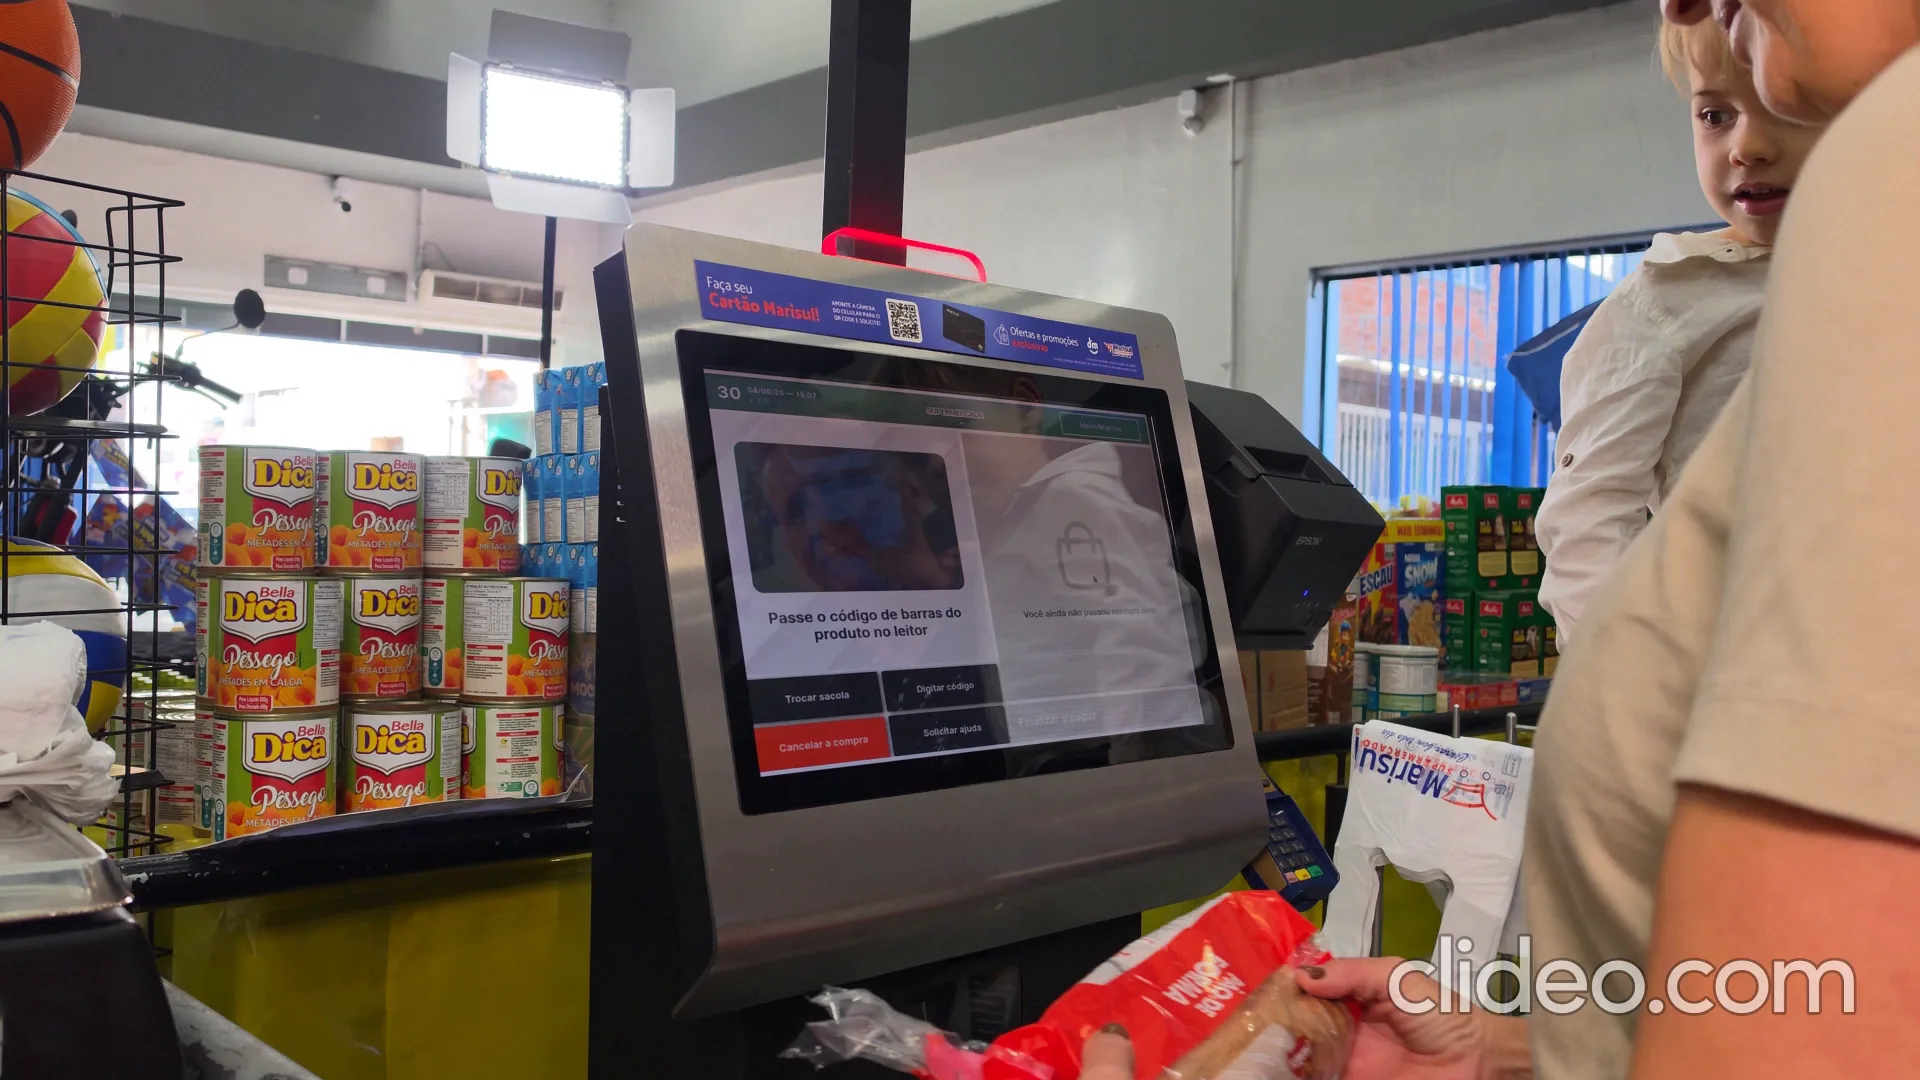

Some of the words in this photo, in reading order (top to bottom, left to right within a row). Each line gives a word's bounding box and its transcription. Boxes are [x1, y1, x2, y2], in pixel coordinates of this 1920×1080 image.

[706, 276, 732, 294] Faça
[734, 284, 752, 294] seu
[708, 291, 760, 313] Cartão
[764, 301, 820, 322] Marisul!
[831, 301, 851, 309] APONTE
[856, 303, 876, 312] CÂMERA
[841, 308, 862, 317] CELULAR
[1010, 326, 1036, 340] Ofertas
[1036, 332, 1042, 340] e
[1042, 334, 1078, 347] promoções
[1011, 339, 1048, 353] exclusivas
[717, 385, 741, 400] 30
[253, 458, 314, 488] Dica
[394, 459, 416, 470] Bella
[353, 462, 418, 491] Dica
[484, 468, 522, 495] Dic
[352, 510, 416, 542] Pêssego
[247, 539, 287, 548] METADES
[348, 540, 388, 549] METADES
[1296, 536, 1323, 546] EPSON
[1360, 564, 1394, 596] ESCAU
[1405, 556, 1438, 588] SNOW
[259, 586, 295, 598] Bella
[399, 585, 418, 595] Bella
[224, 591, 298, 622] Dica
[360, 589, 419, 617] Dica
[529, 591, 569, 619] Dic
[769, 611, 813, 624] Passe
[817, 614, 826, 622] o
[830, 609, 877, 624] código
[881, 608, 898, 620] de
[901, 608, 942, 619] barras
[946, 607, 962, 618] do
[1023, 610, 1043, 618] Você
[1045, 609, 1066, 618] ainda
[1068, 608, 1082, 617] não
[1084, 608, 1110, 618] passou
[814, 628, 870, 643] produto
[874, 627, 891, 637] no
[894, 625, 928, 637] leitor
[223, 644, 297, 680] Pêssego
[219, 677, 251, 686] METADES
[254, 677, 268, 686] EM
[270, 677, 302, 687] CALDA
[916, 683, 944, 695] Digitar
[946, 681, 975, 693] código
[785, 694, 818, 704] Trocar
[819, 691, 850, 701] sacola
[298, 724, 326, 737] Bella
[391, 720, 424, 731] Bella
[923, 726, 958, 737] Solicitar
[960, 724, 982, 735] ajuda
[252, 731, 327, 763] Dica
[356, 725, 426, 754] Dica
[779, 741, 823, 753] Cancelar
[825, 740, 831, 748] a
[834, 736, 869, 748] compra
[1355, 737, 1450, 799] Marisul
[355, 775, 426, 806] Pêssego
[251, 785, 326, 819] Pêssego
[245, 818, 290, 828] METADES
